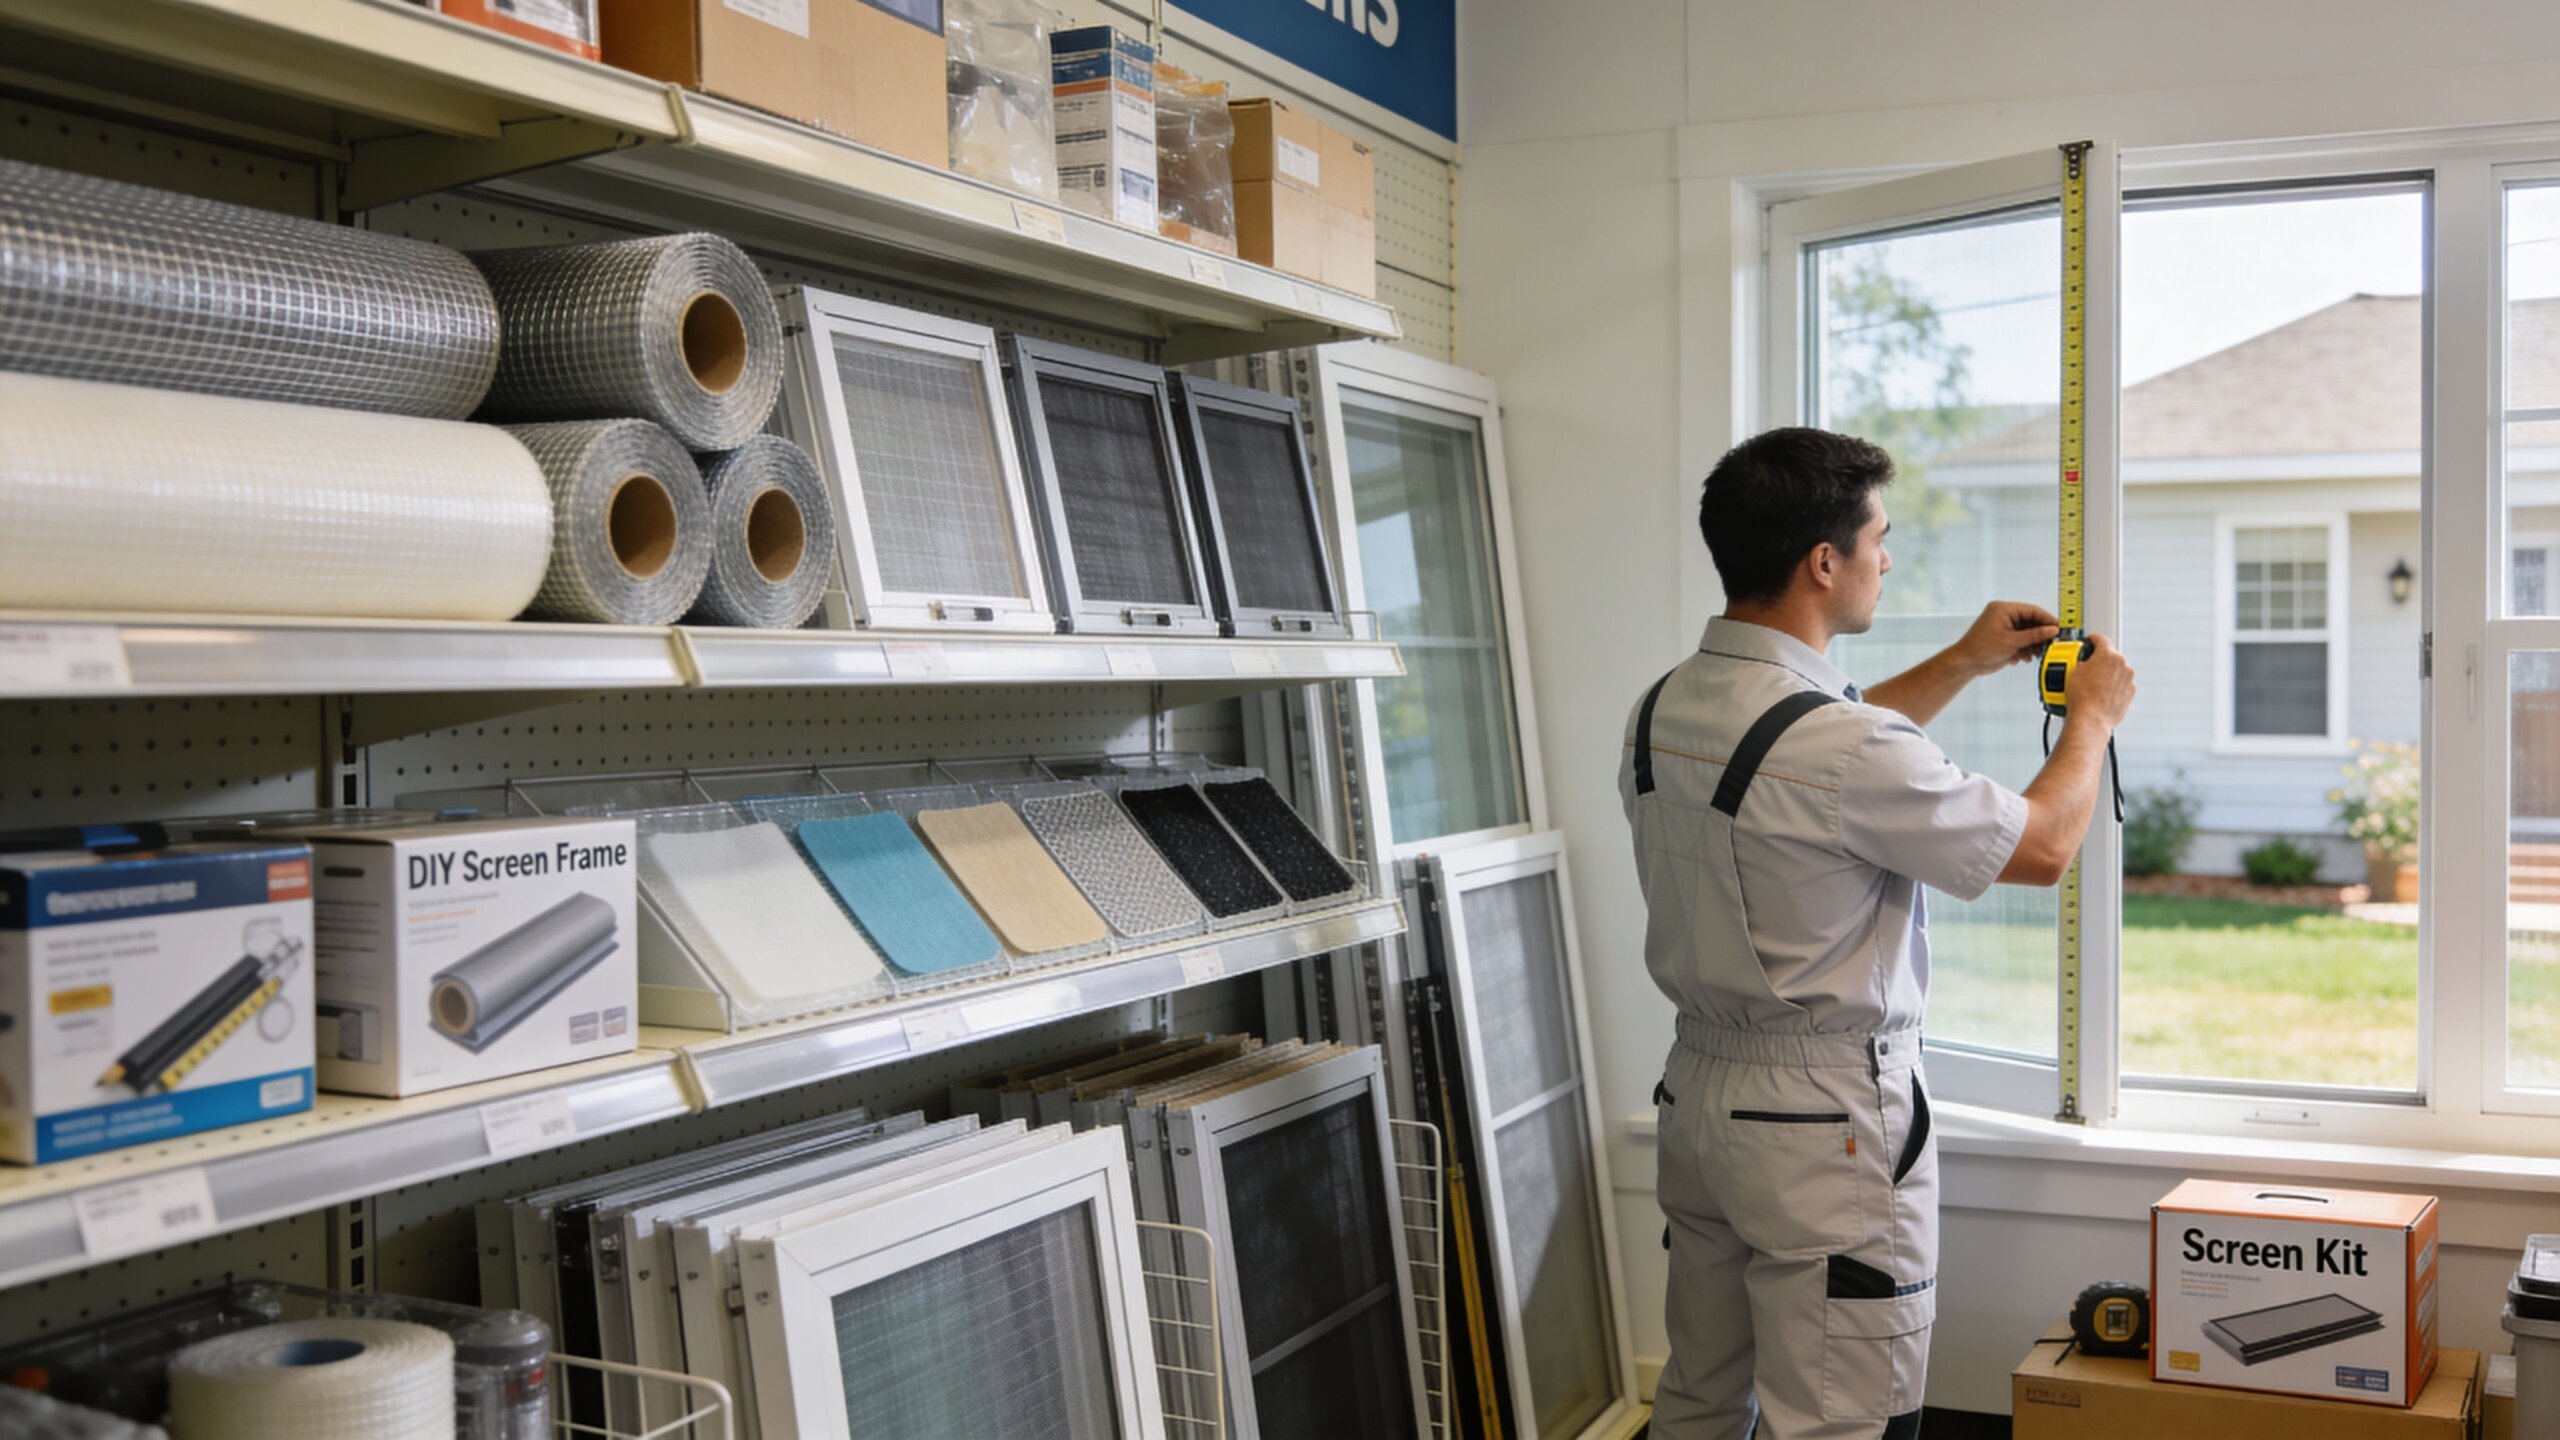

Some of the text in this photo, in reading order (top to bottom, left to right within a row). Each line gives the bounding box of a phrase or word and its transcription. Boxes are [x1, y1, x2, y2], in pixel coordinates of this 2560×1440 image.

[408, 842, 627, 890] DIY Screen Frame
[2182, 1227, 2369, 1277] Screen Kit
